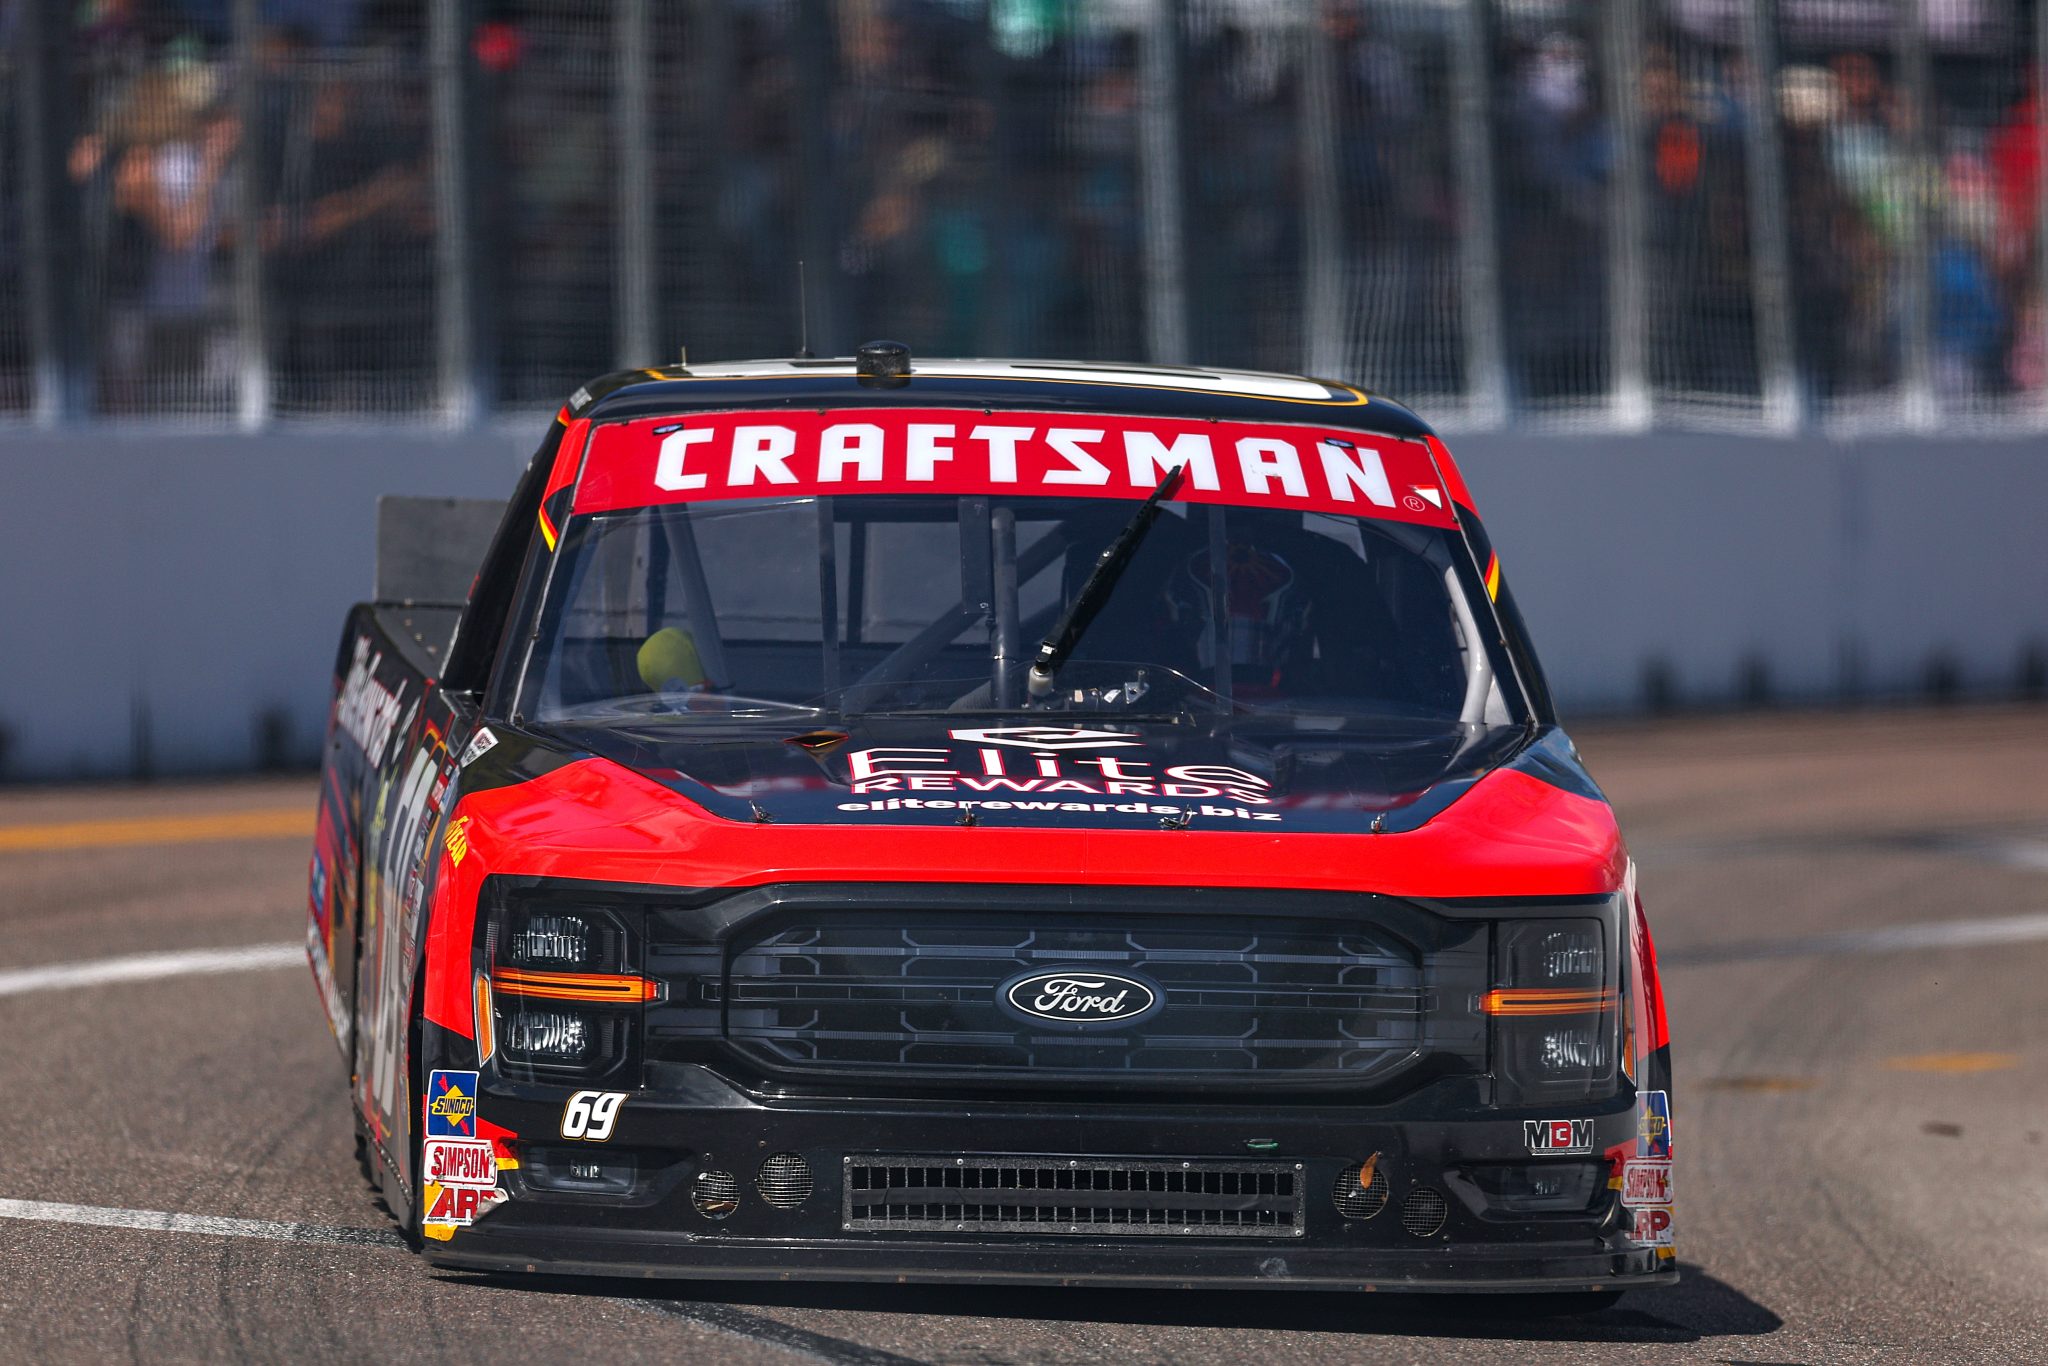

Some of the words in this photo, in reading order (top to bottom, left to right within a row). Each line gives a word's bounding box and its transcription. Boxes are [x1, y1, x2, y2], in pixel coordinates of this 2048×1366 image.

[655, 424, 1396, 508] CRAFTSMAN
[848, 748, 1272, 791] Elite
[851, 777, 1272, 804] REWARDS
[837, 798, 1282, 822] eliterewards.biz
[1034, 979, 1129, 1013] Ford
[434, 1097, 473, 1115] SUNOCO
[560, 1090, 630, 1142] 69
[431, 1146, 491, 1180] SIMPSON
